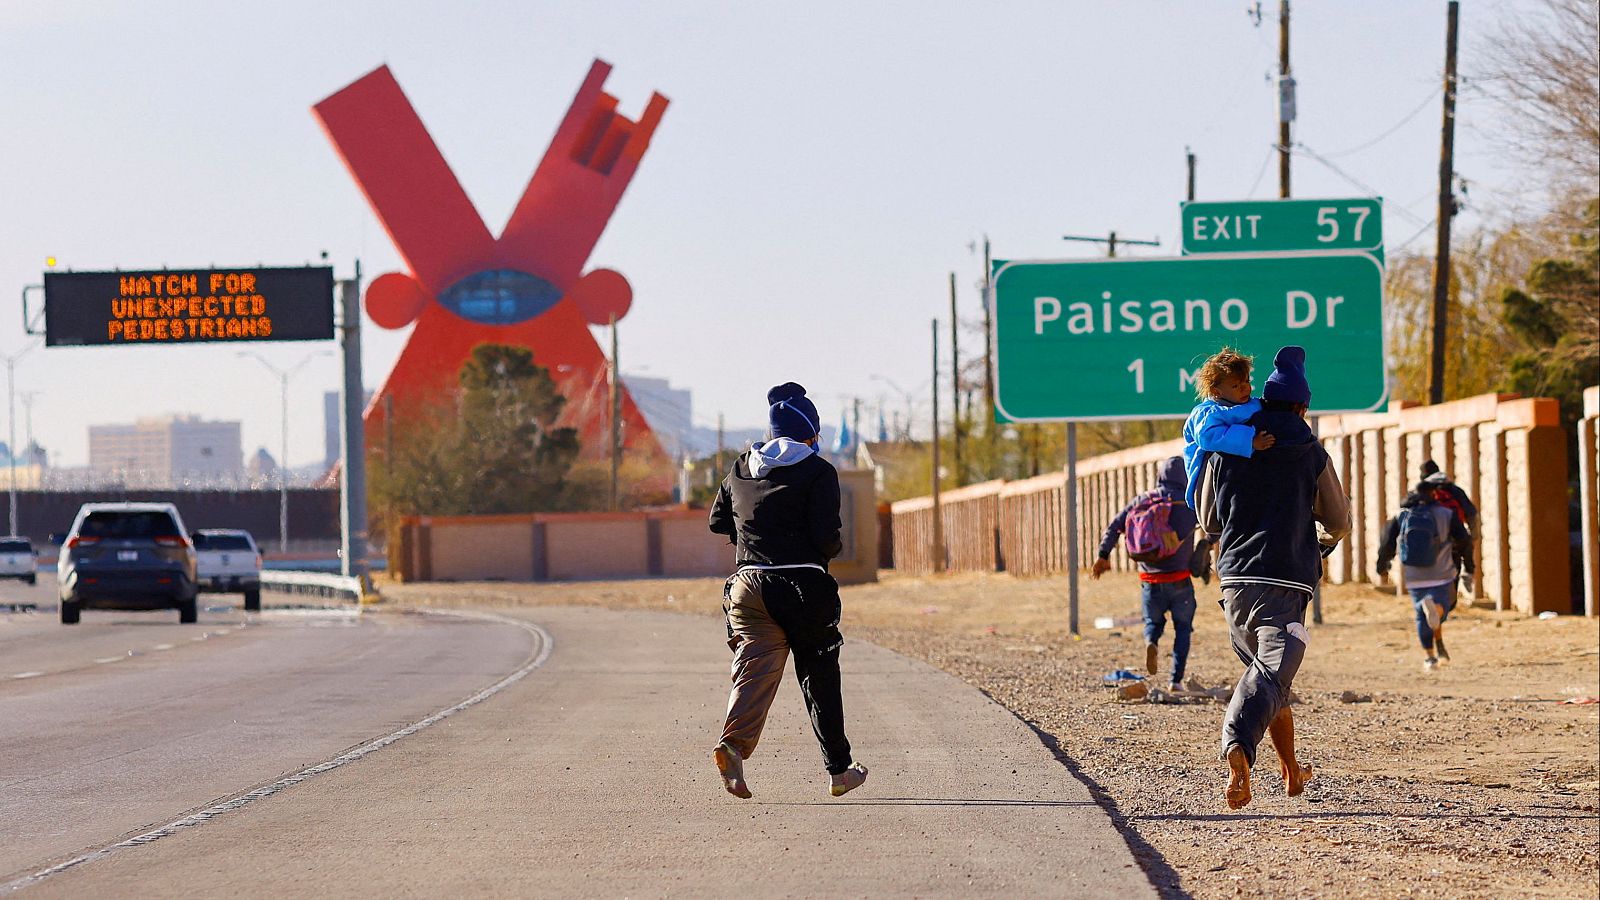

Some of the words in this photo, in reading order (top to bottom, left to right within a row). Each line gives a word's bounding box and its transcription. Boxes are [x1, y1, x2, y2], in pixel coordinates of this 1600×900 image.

[1193, 215, 1261, 240] EXIT
[1317, 207, 1371, 242] 57
[120, 275, 198, 296] WATCH
[209, 273, 257, 294] FOR
[111, 295, 267, 318] UNEXPECTED
[1034, 291, 1249, 334] Paisano
[1286, 290, 1345, 329] Dr
[108, 316, 273, 340] PEDESTRIANS
[1127, 358, 1144, 393] 1
